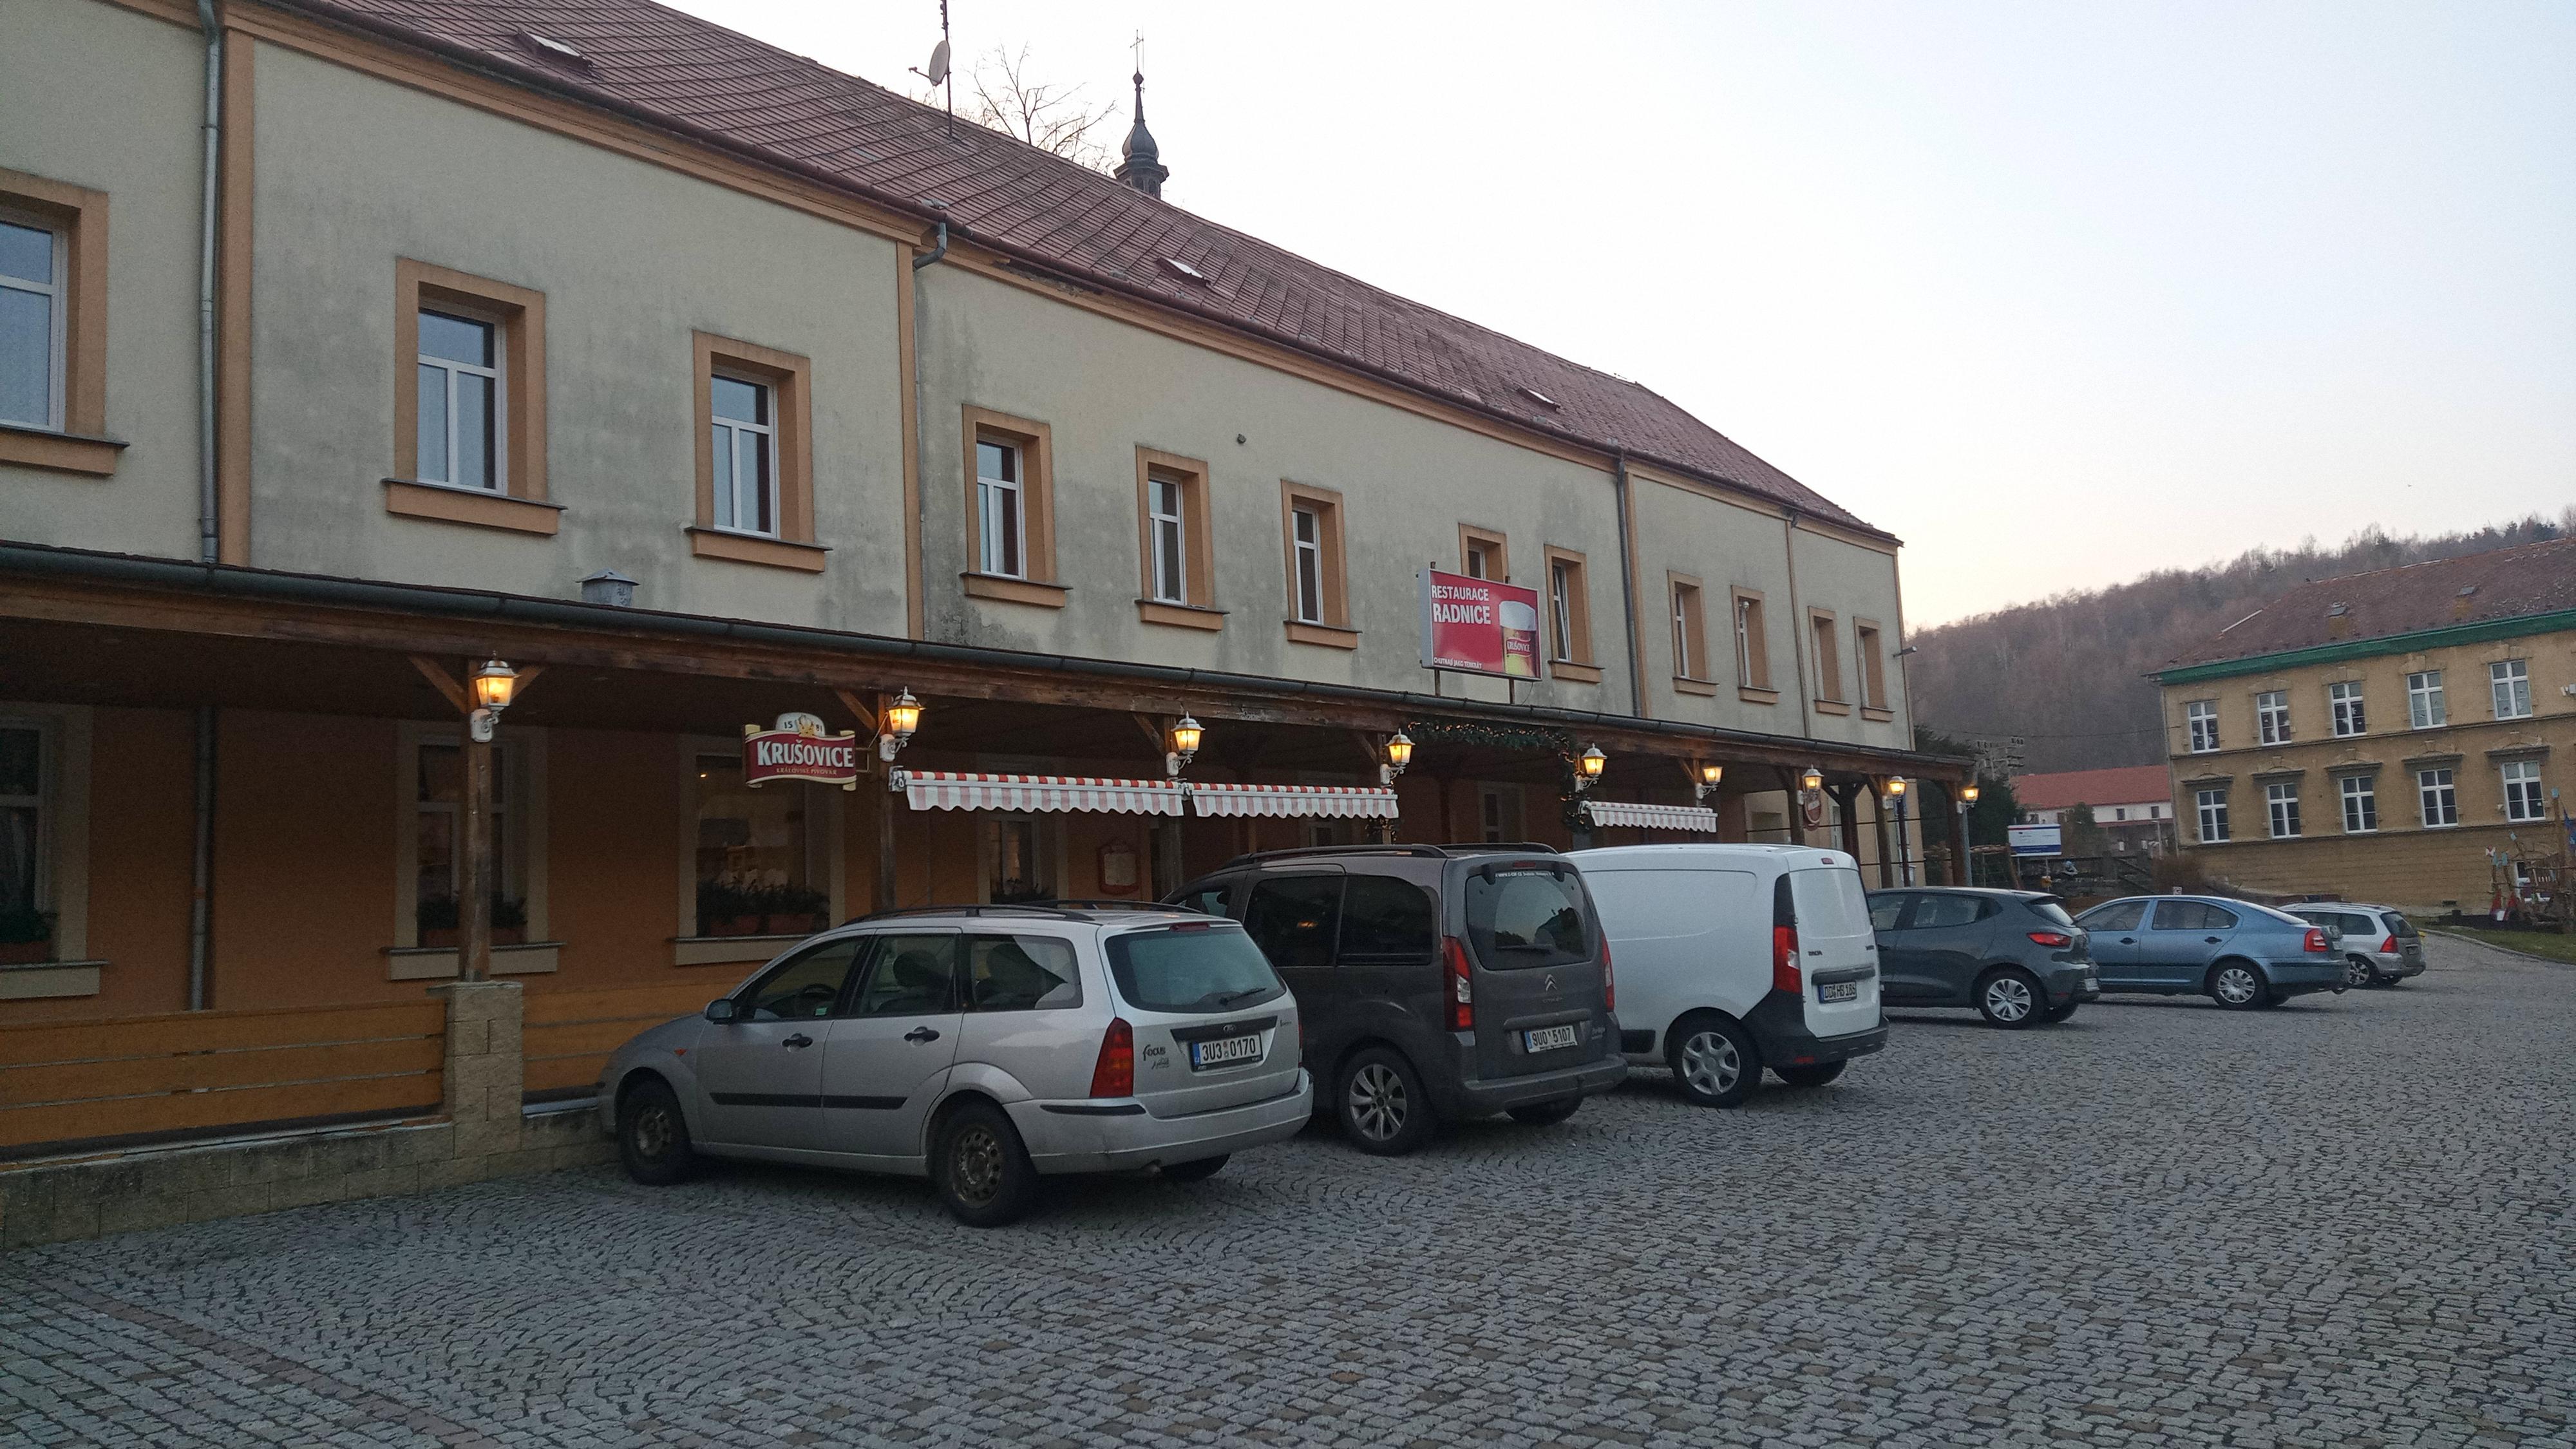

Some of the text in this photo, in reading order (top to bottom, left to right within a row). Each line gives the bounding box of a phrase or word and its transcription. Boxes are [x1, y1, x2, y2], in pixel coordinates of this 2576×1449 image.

[1431, 585, 1490, 601] RESTAURACE
[1432, 602, 1492, 625] RADNICE
[757, 739, 855, 768] KRUŠOVICE
[1553, 1027, 1571, 1043] 5107
[1202, 1037, 1256, 1061] 3U3 0170
